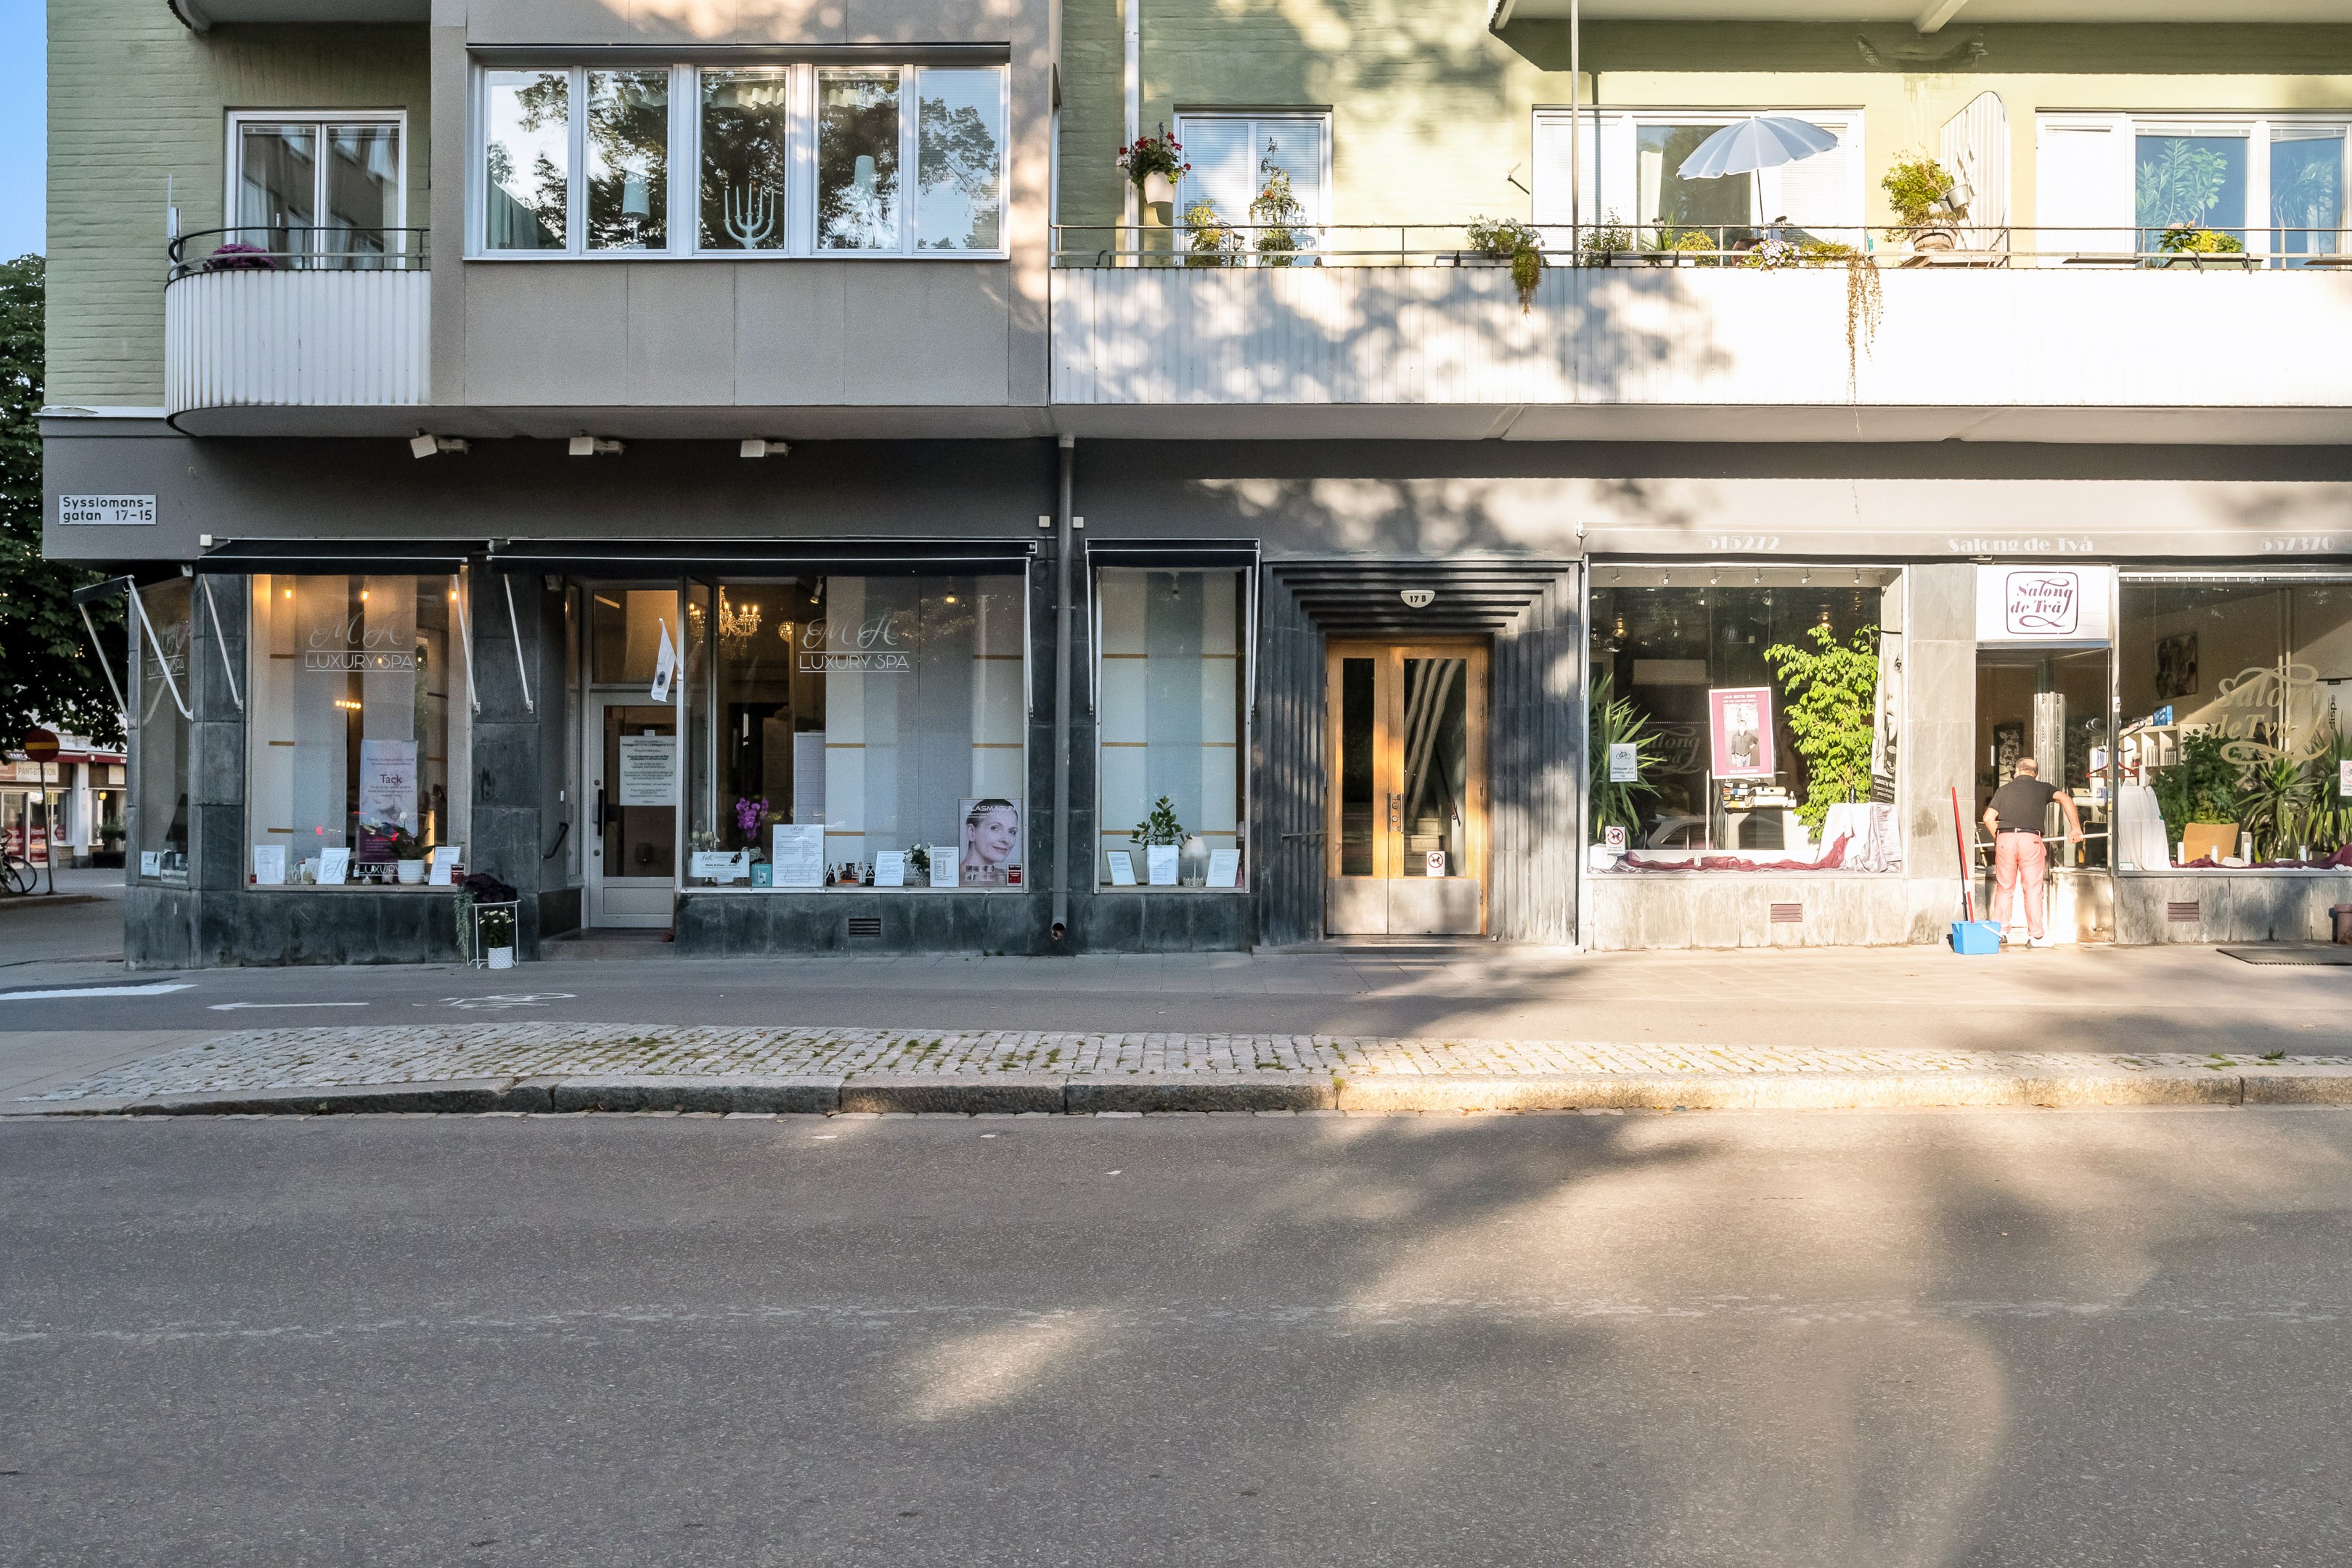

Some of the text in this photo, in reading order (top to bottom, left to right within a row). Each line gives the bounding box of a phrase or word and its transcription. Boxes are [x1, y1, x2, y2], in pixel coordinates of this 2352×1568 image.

[63, 497, 152, 510] Sysslomans-
[63, 510, 152, 523] gatan 17-15
[1706, 535, 1780, 551] 515272
[1948, 536, 2094, 552] Salong de Två
[2260, 536, 2335, 552] 557370
[2017, 579, 2074, 600] Salong
[2010, 600, 2063, 613] de Två
[306, 654, 415, 669] LUXURY SPA
[799, 655, 910, 669] LUXURY SPA
[17, 767, 57, 776] PANT-STTION
[379, 774, 403, 784] Tack
